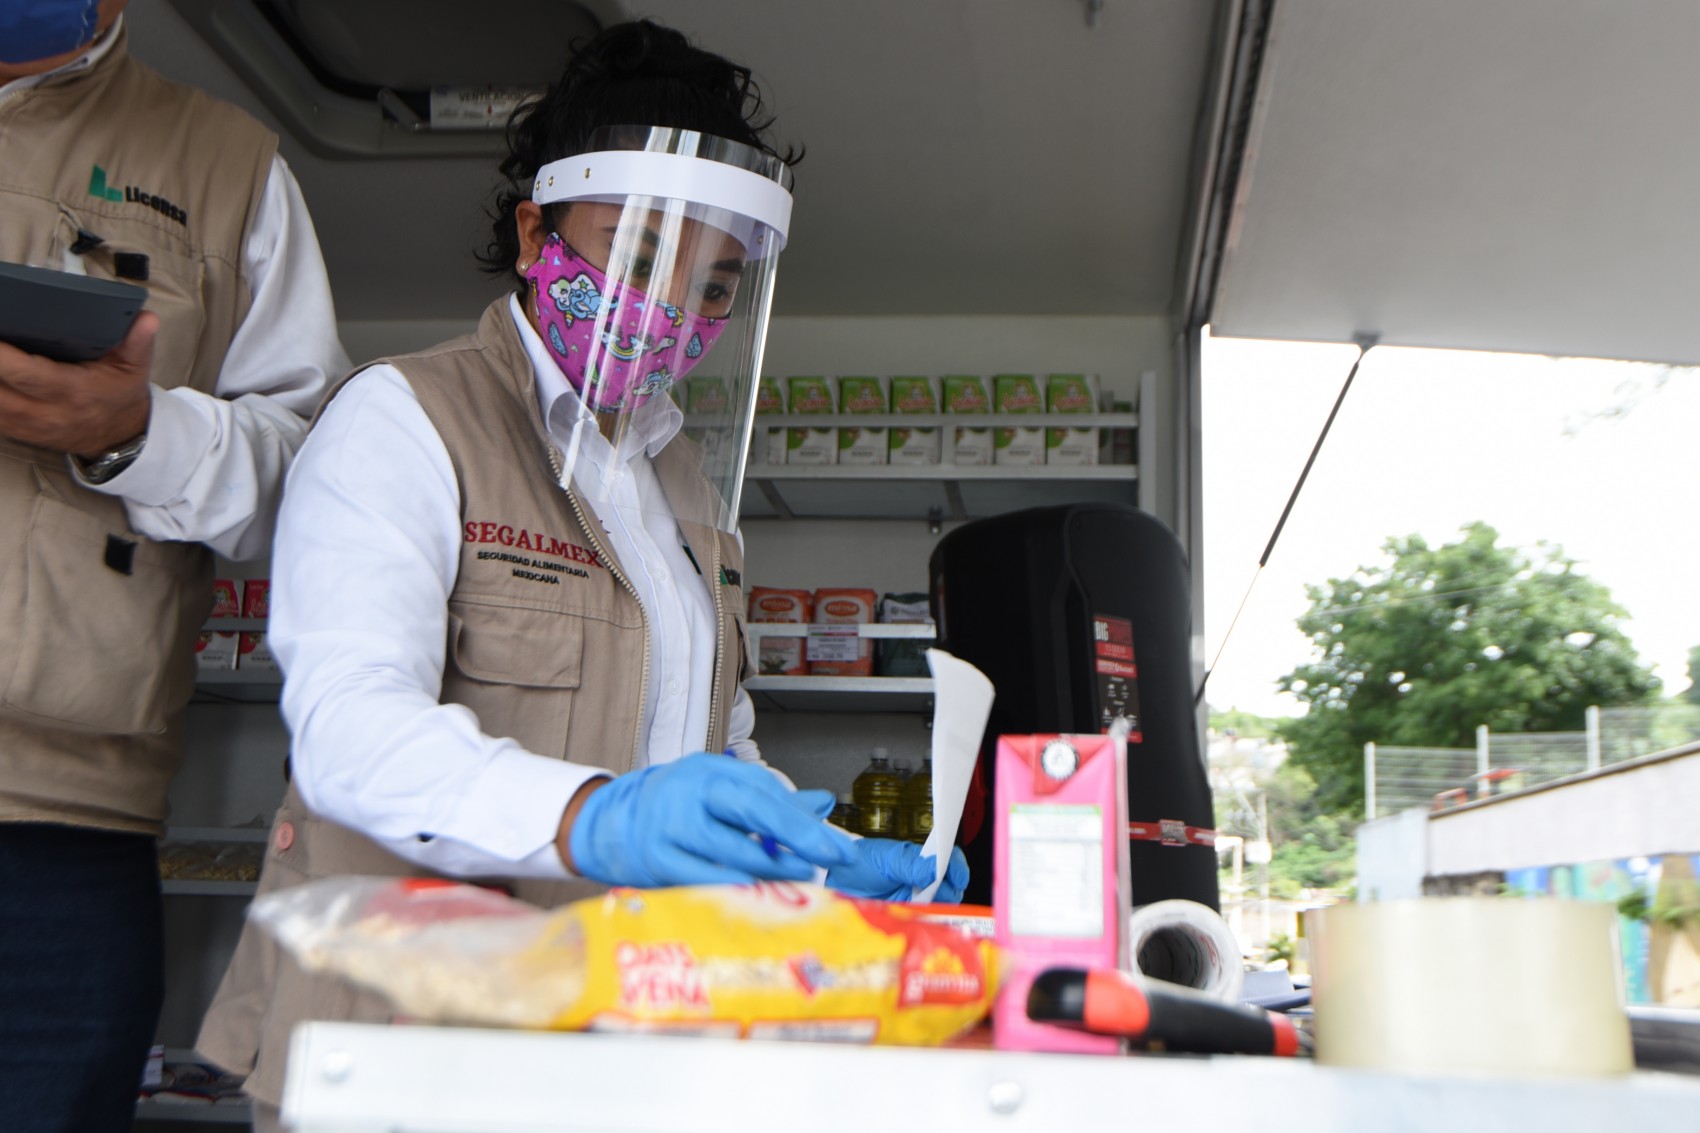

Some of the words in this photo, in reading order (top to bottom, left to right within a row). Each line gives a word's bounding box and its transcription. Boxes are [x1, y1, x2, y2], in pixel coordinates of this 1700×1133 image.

[464, 521, 603, 568] SEGALMEX
[477, 551, 530, 566] SEGURIDAD
[532, 559, 589, 578] ALIMENTARIA
[512, 568, 560, 585] MEXICANA
[1094, 621, 1109, 641] BIG
